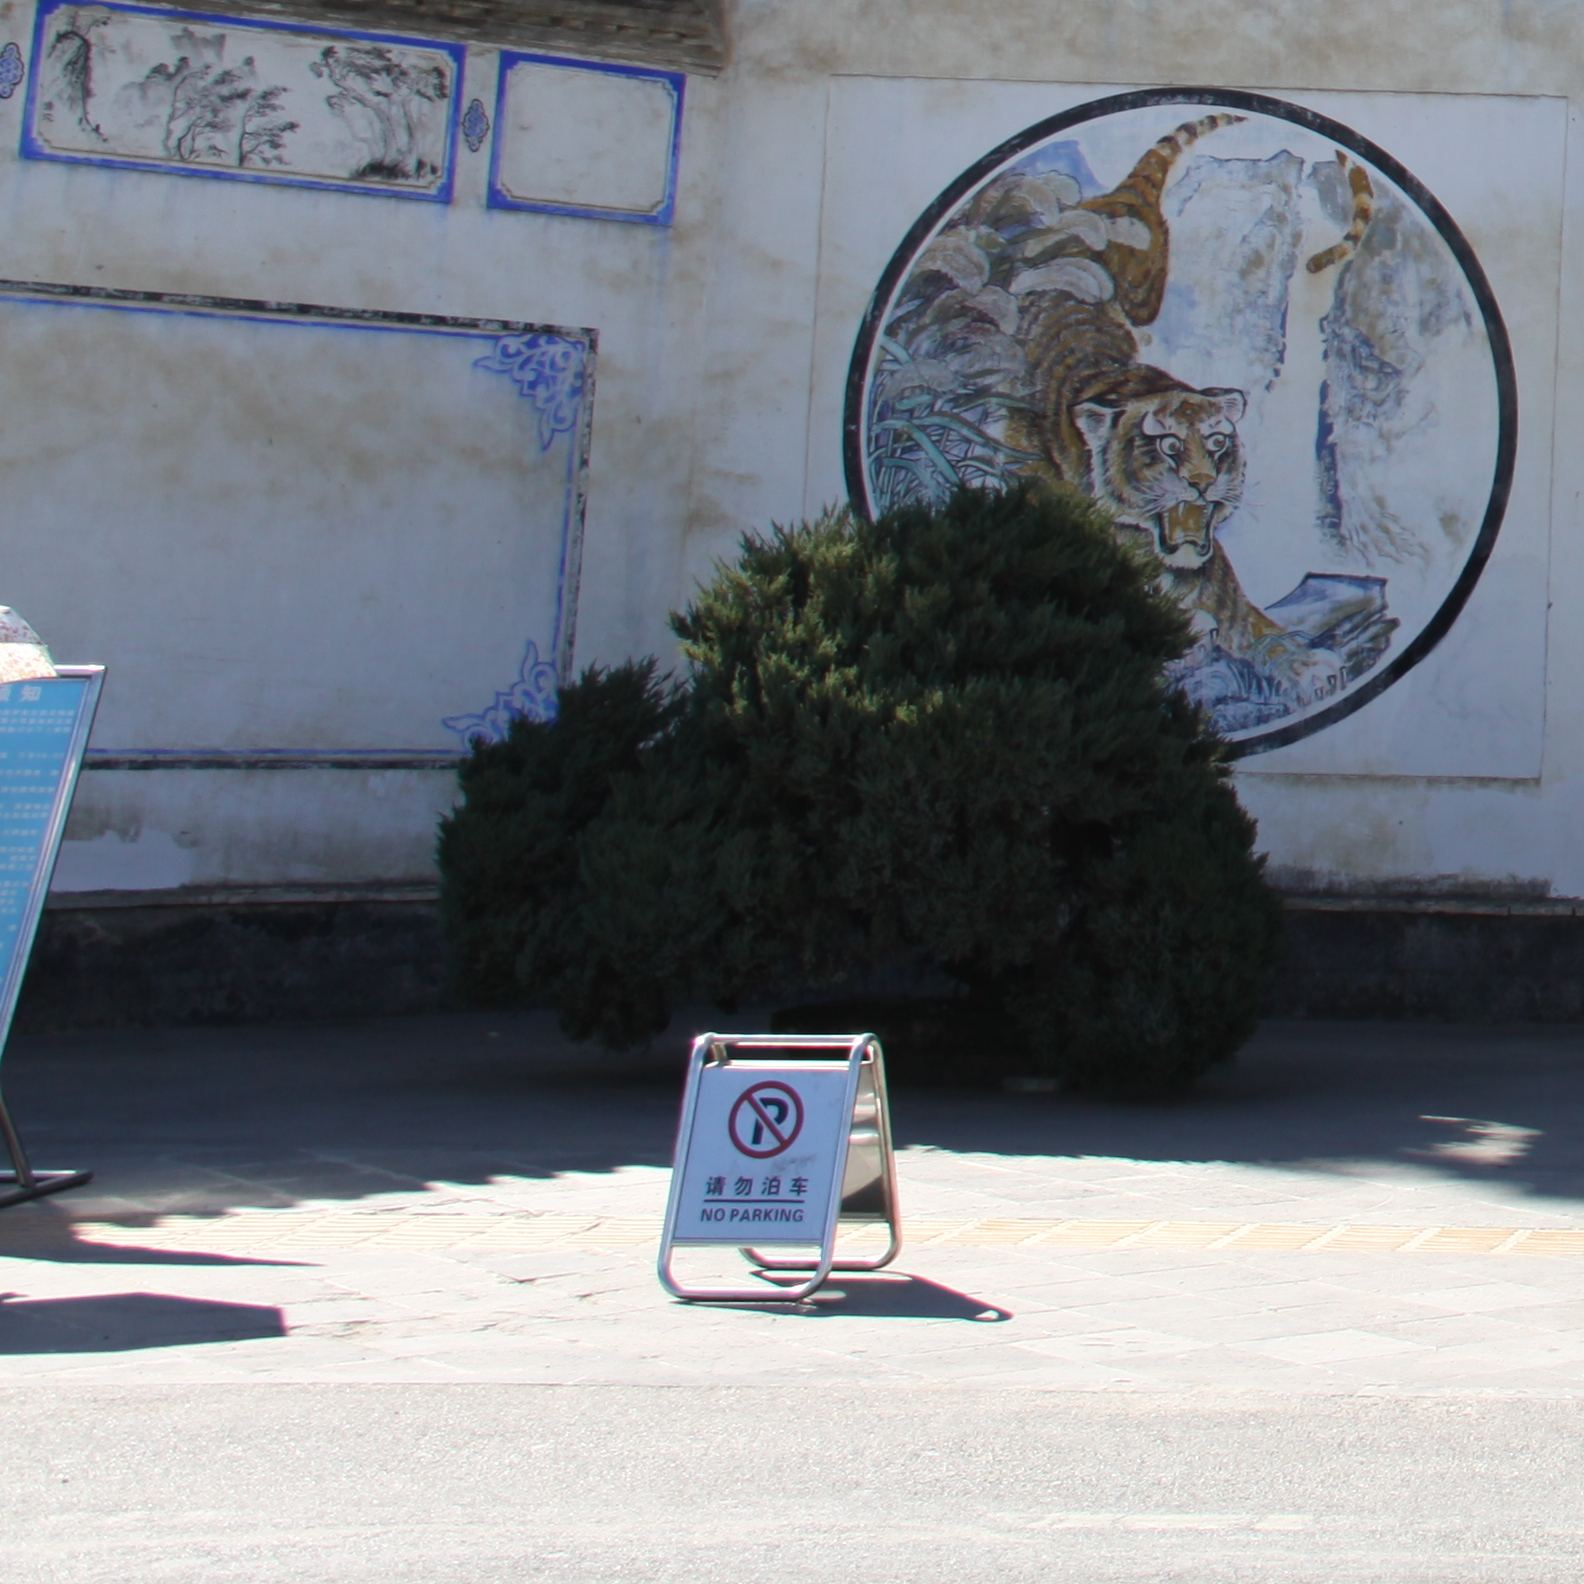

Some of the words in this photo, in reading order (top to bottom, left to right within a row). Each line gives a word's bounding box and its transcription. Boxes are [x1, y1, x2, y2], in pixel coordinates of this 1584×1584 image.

[705, 1175, 809, 1196] 请勿泊车
[700, 1207, 726, 1222] NO
[729, 1208, 805, 1223] PARKING
